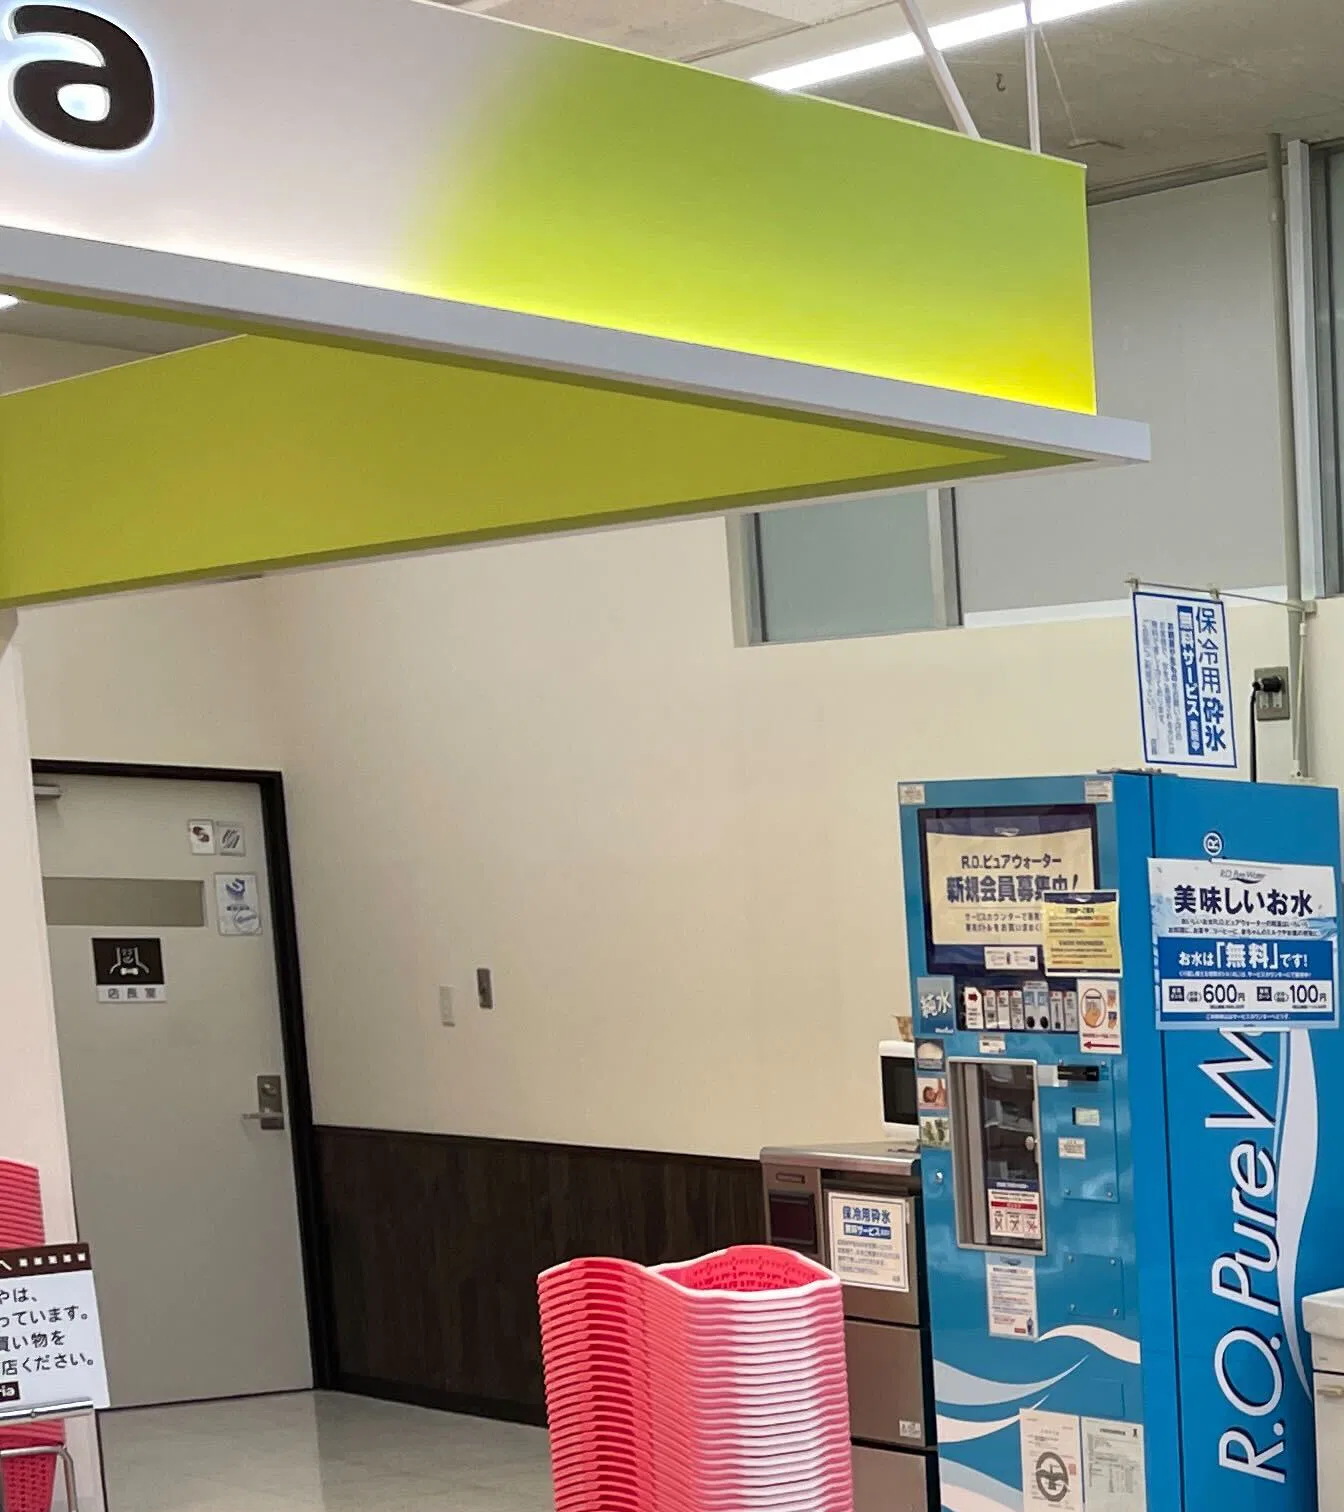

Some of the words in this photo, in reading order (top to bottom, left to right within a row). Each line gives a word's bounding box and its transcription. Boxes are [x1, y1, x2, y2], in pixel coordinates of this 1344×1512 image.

[1196, 605, 1227, 751] 保冷用砕氷
[1173, 884, 1313, 918] 美味しいお水
[1178, 941, 1308, 970] お水は「無料」です!
[1211, 1136, 1280, 1316] Pure
[2, 1352, 95, 1376] 店ください。
[1216, 1329, 1287, 1484] R.O.
